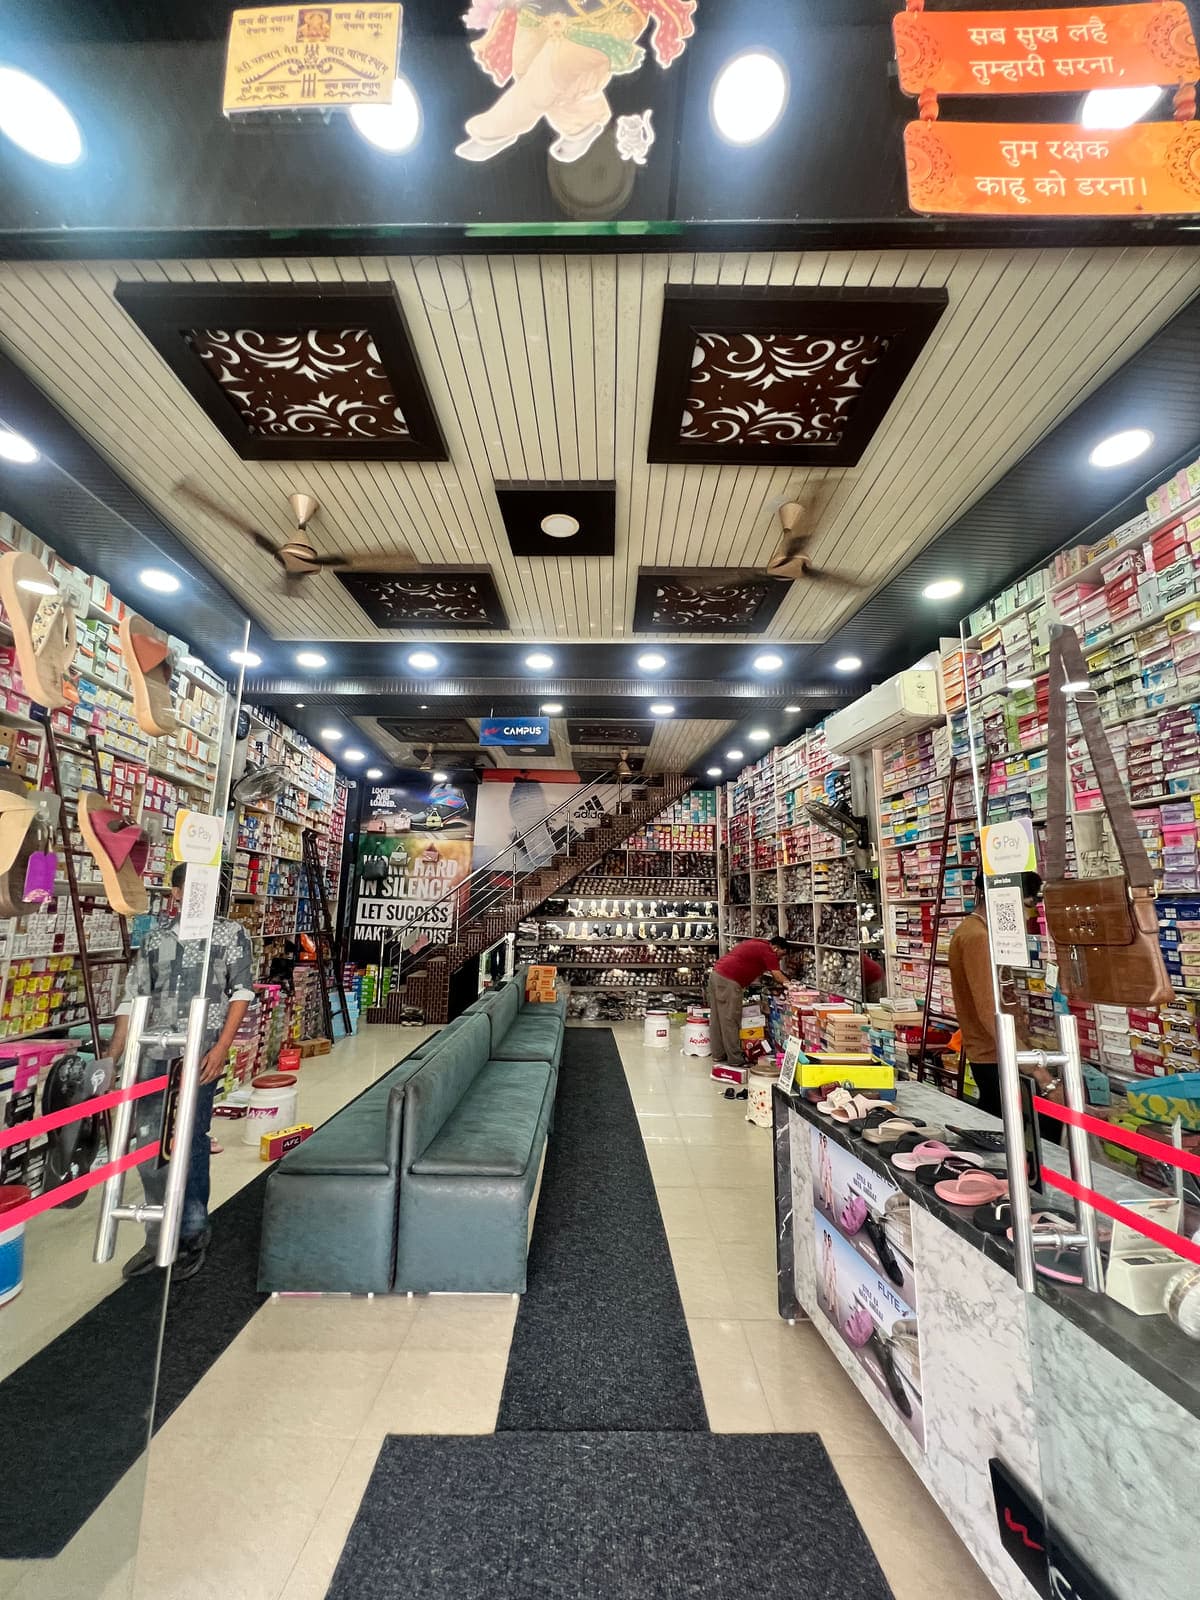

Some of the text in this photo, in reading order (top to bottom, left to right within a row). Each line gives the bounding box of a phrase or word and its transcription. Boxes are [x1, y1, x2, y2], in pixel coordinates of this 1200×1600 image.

[968, 16, 1108, 50] सब सुख लहै
[969, 54, 1045, 85] तुम्हारी
[1000, 140, 1109, 167] तुम रक्षक
[974, 176, 1032, 203] काहू
[1034, 170, 1066, 196] को
[503, 726, 542, 735] CAMPUS
[574, 810, 604, 819] adida
[359, 876, 378, 896] IN
[361, 903, 449, 923] LET SUCCESS
[353, 925, 384, 941] MAK
